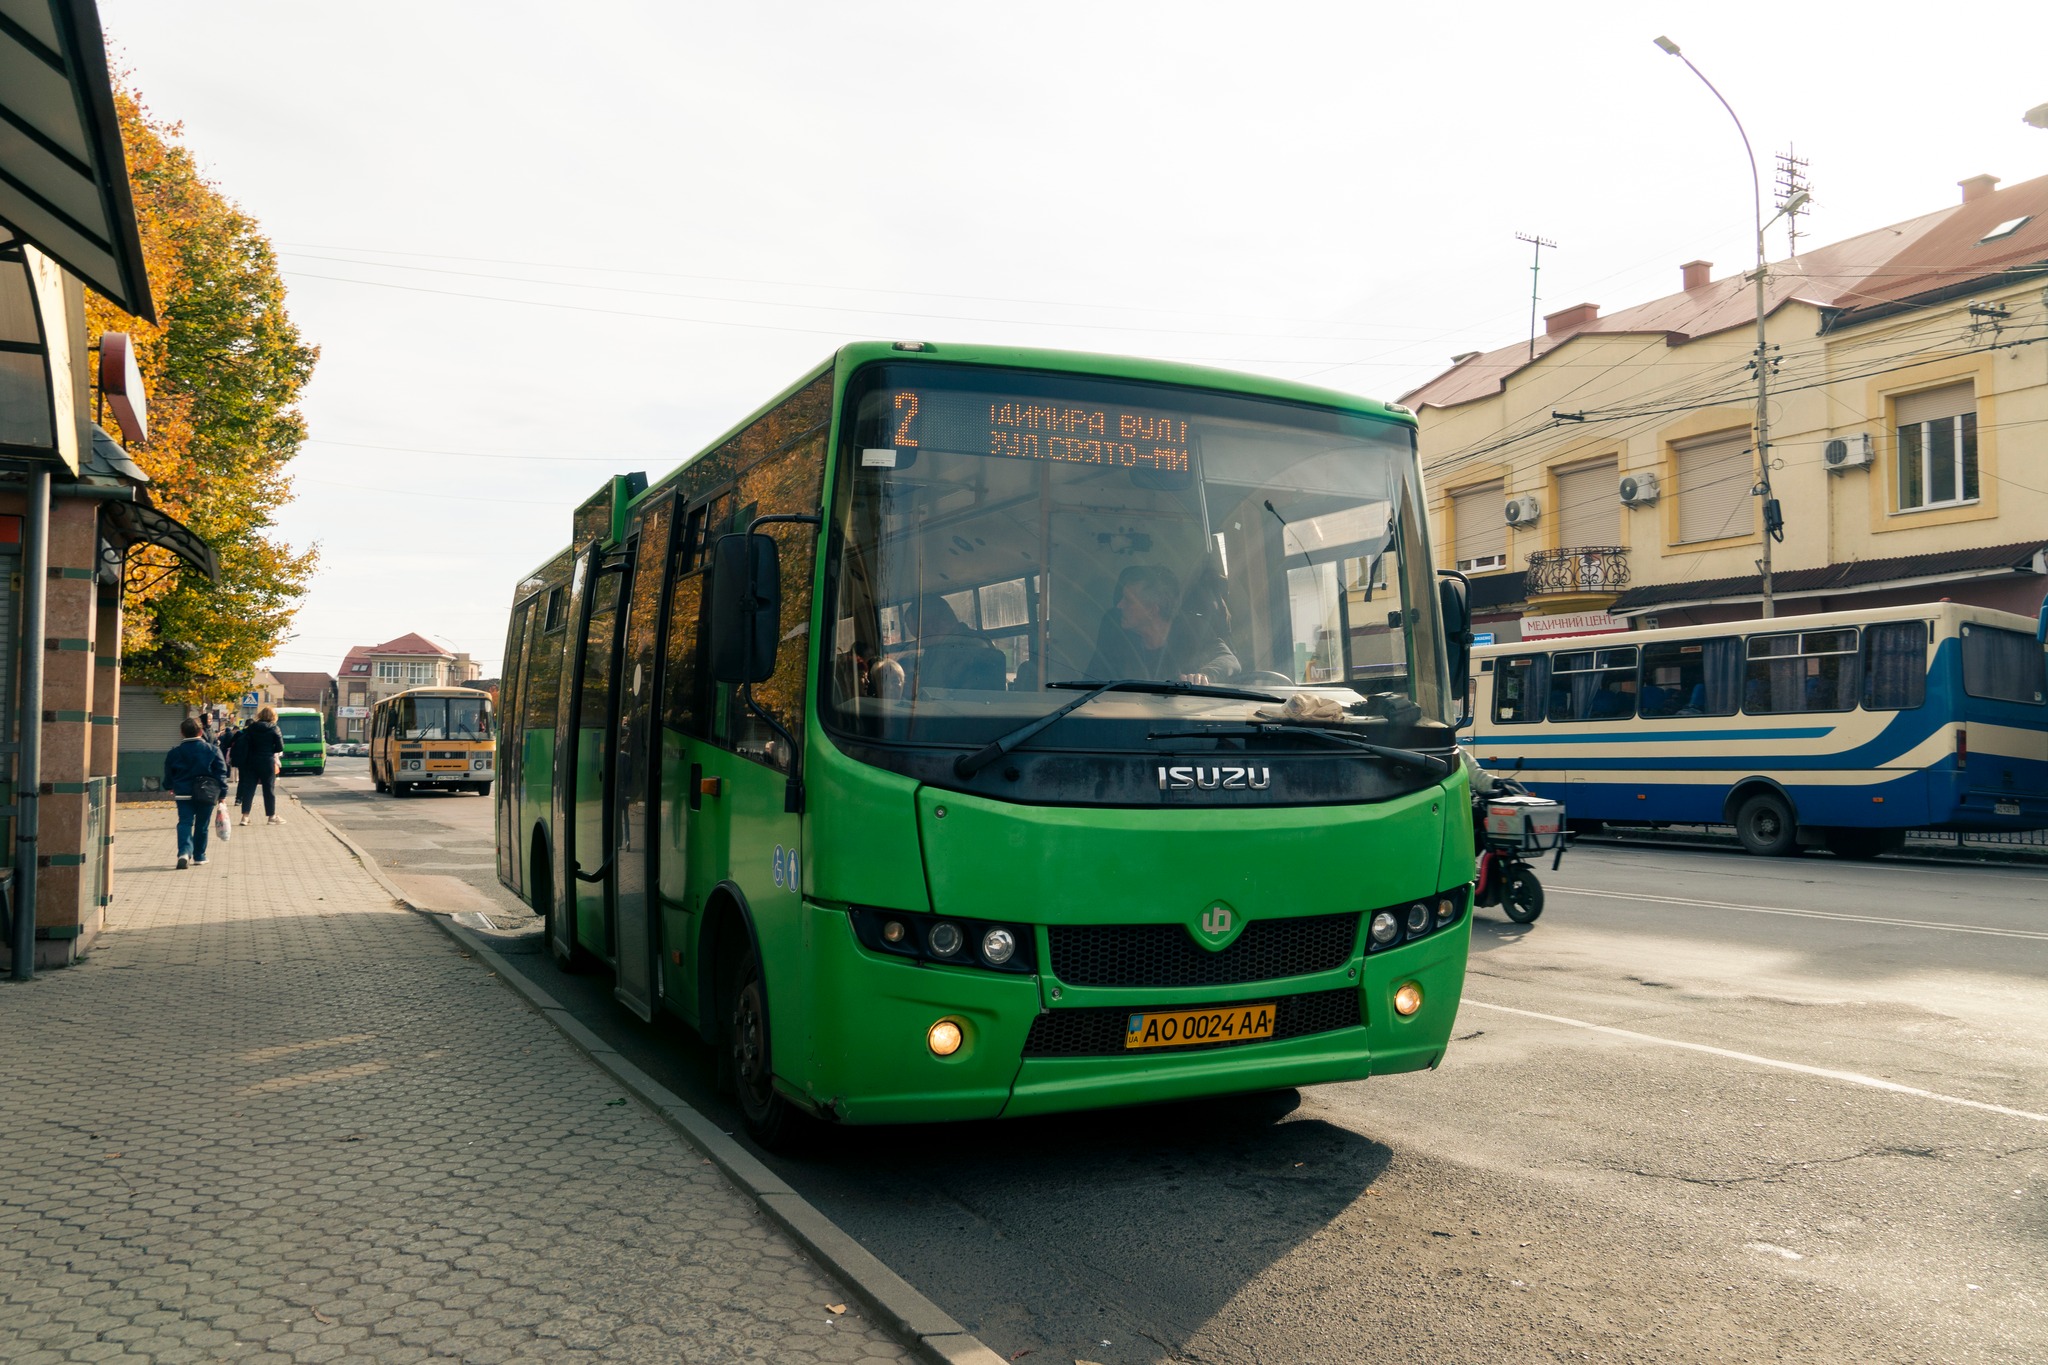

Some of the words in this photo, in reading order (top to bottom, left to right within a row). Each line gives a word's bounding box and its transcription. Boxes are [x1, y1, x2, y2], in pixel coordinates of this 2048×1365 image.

[894, 392, 918, 447] 2
[1527, 615, 1583, 631] МЕДИЧНИЙ
[1158, 766, 1271, 790] ISUZU
[1182, 1012, 1235, 1040] 0024
[1238, 1009, 1268, 1035] AA
[1128, 1035, 1139, 1044] UA
